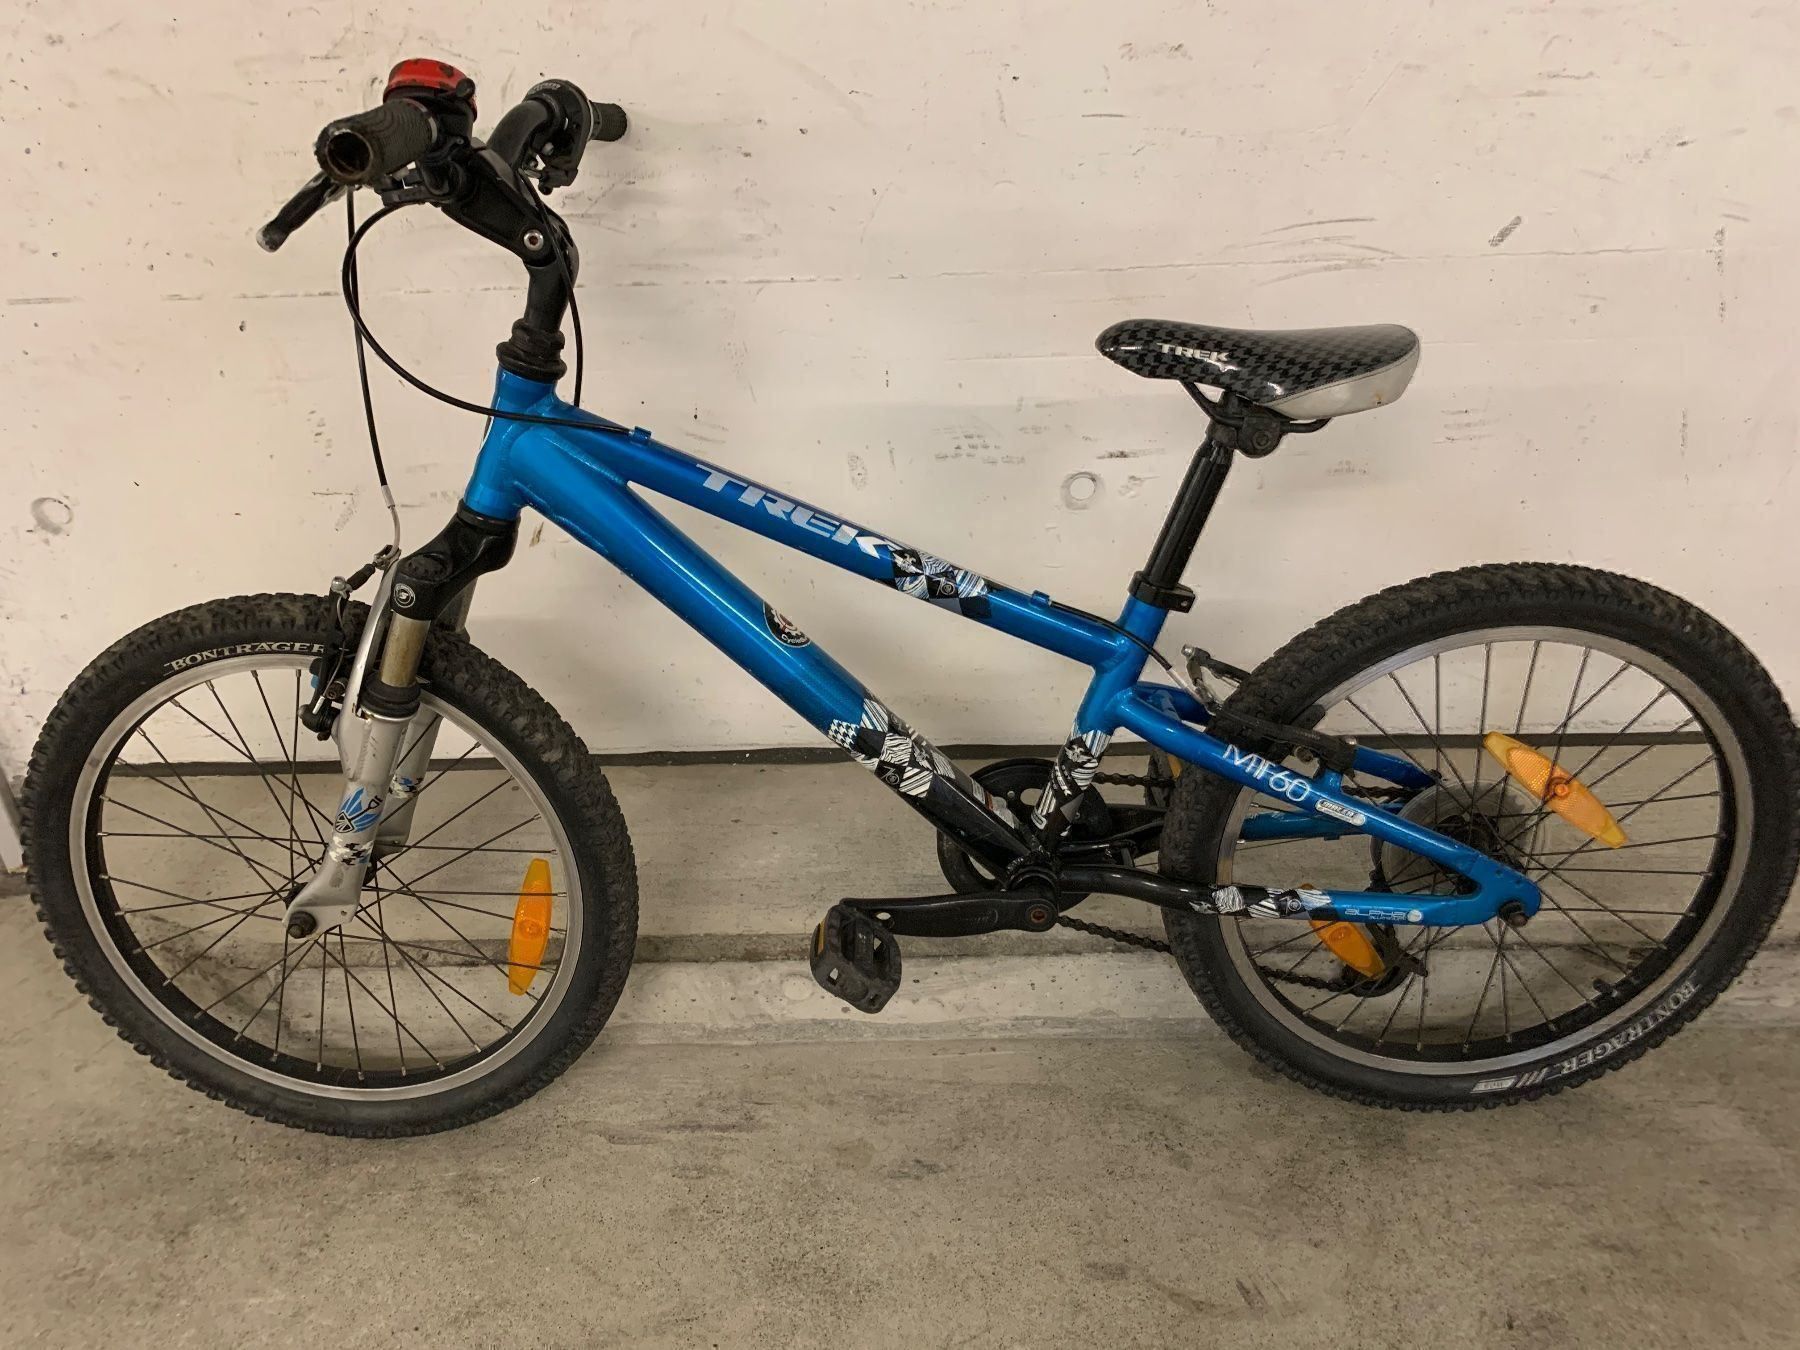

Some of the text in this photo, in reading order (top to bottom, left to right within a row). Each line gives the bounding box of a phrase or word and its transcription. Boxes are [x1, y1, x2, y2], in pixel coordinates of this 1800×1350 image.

[1156, 343, 1229, 361] TREK
[696, 463, 903, 560] TREK
[168, 642, 324, 672] BONTRAGER
[1559, 980, 1697, 1075] BONTRAGER
